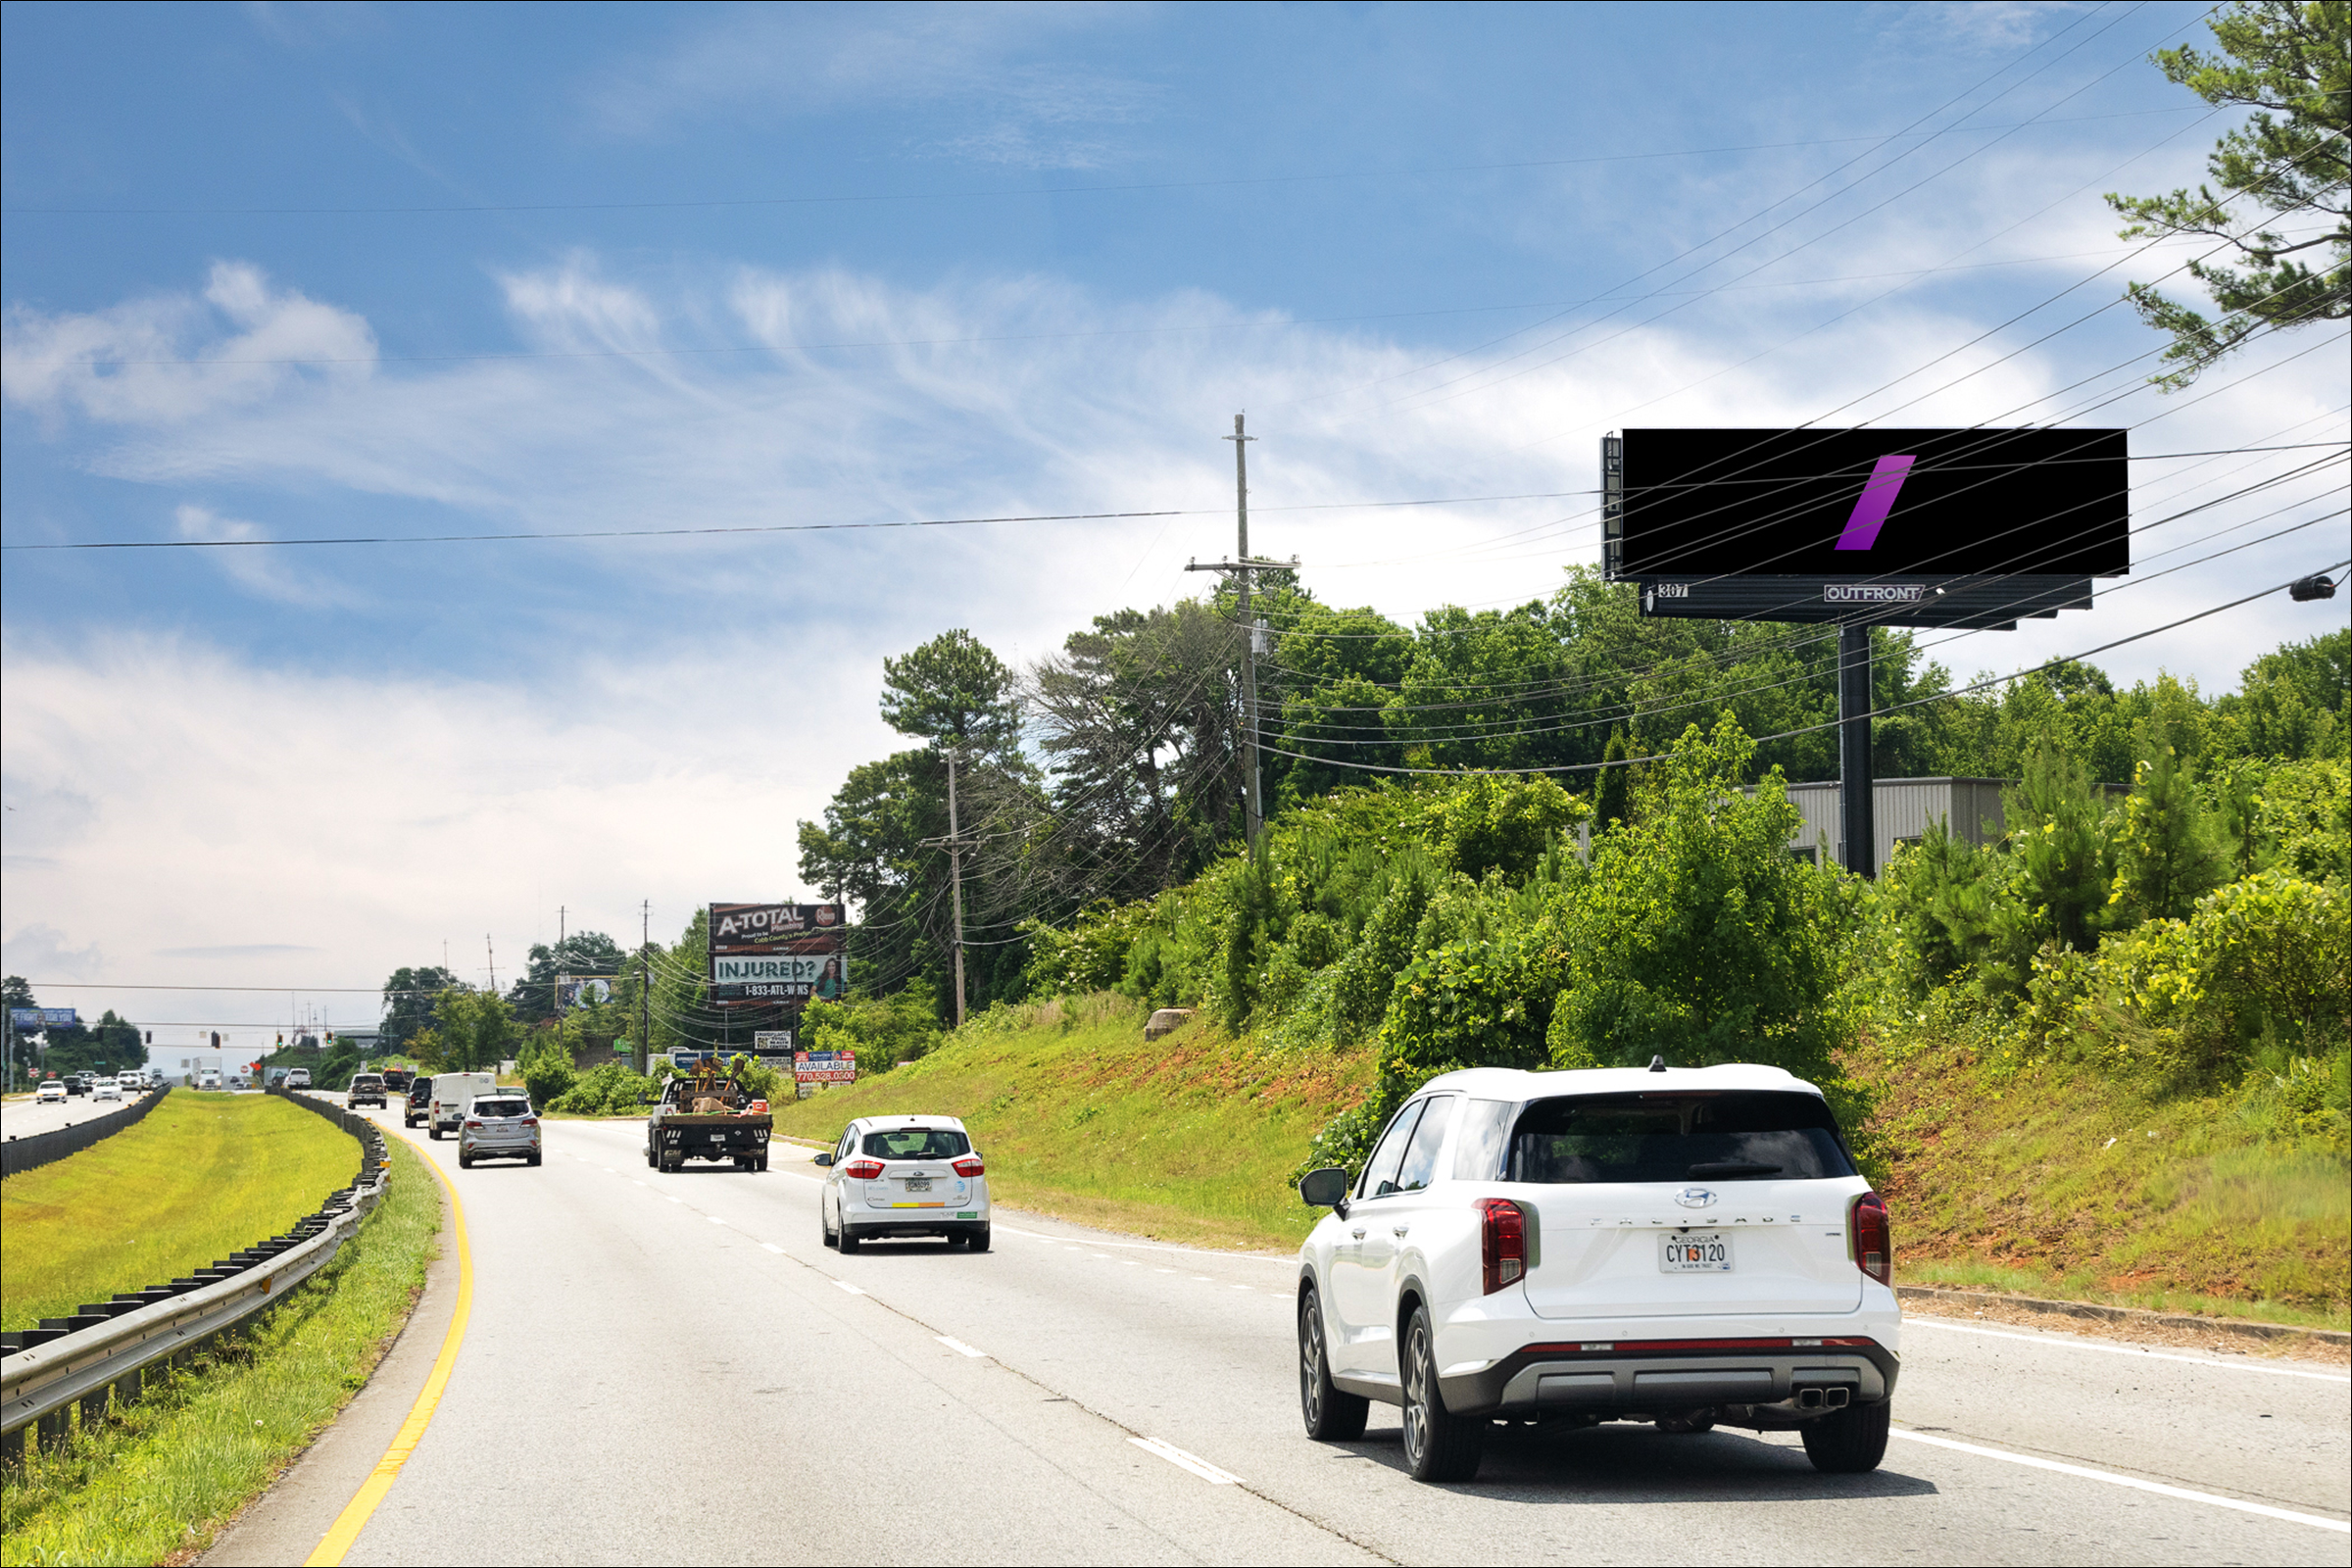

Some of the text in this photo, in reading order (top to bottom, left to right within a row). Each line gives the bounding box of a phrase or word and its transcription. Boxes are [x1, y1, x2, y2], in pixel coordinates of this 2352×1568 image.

[1660, 584, 1686, 597] 307
[1827, 587, 1918, 600] OUTFRONT
[717, 906, 804, 937] A-TOTAL
[771, 922, 805, 932] Plumbing
[718, 960, 816, 978] INJURED?
[746, 984, 808, 996] 1-833-ATL-WNS
[798, 1061, 853, 1071] AVAILABLE
[1666, 1244, 1725, 1262] CYT3120
